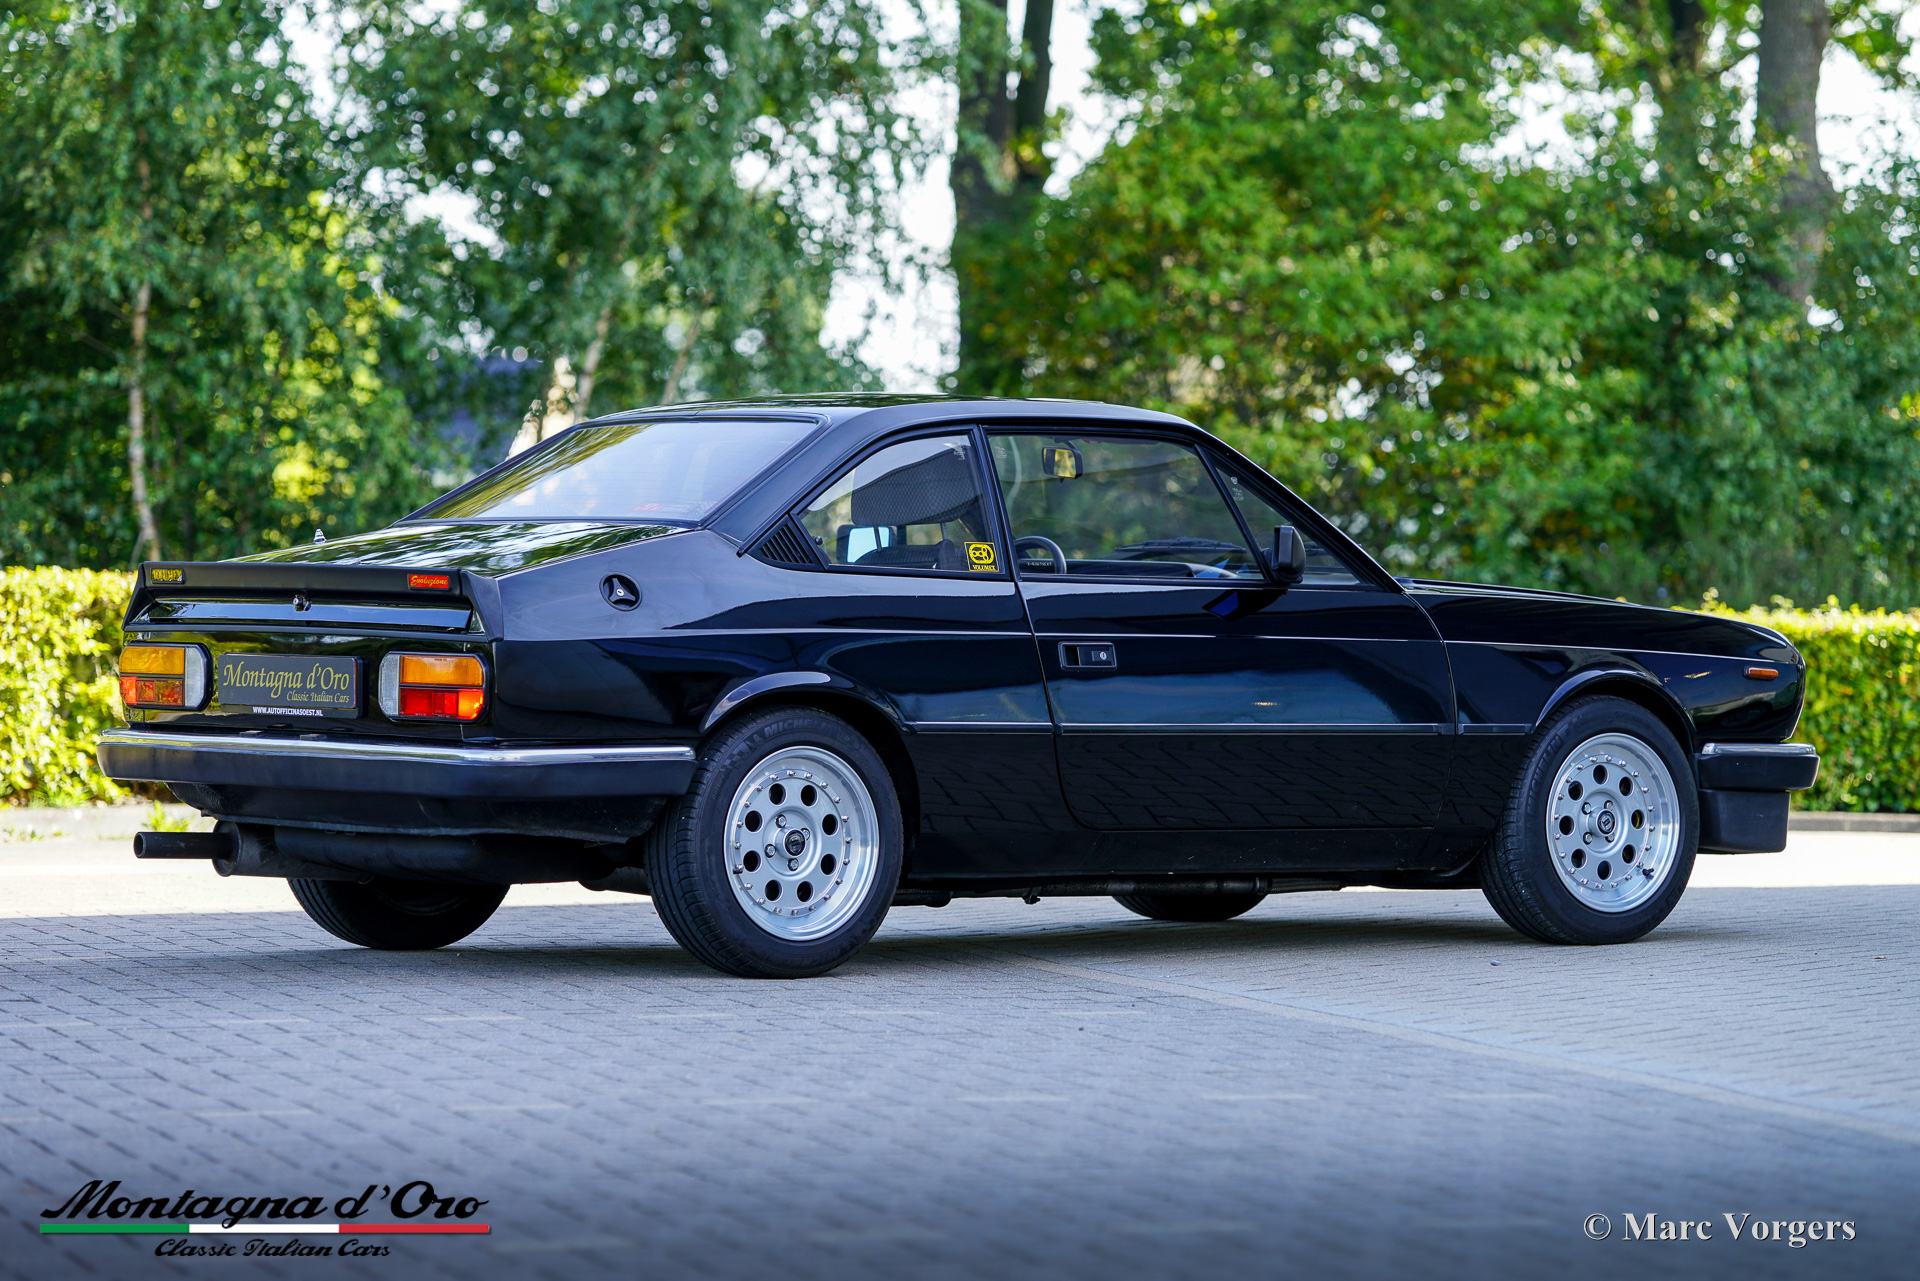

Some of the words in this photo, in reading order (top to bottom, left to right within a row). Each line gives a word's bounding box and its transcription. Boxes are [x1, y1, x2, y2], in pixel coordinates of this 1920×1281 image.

[410, 575, 448, 587] Evoluzione
[223, 661, 303, 698] Montagna
[307, 663, 350, 690] d'Oro
[286, 690, 309, 702] Classic
[310, 691, 333, 703] Italian
[334, 692, 350, 703] Cars
[252, 706, 324, 717] WWW.AUTOFFICINASOEST.NL
